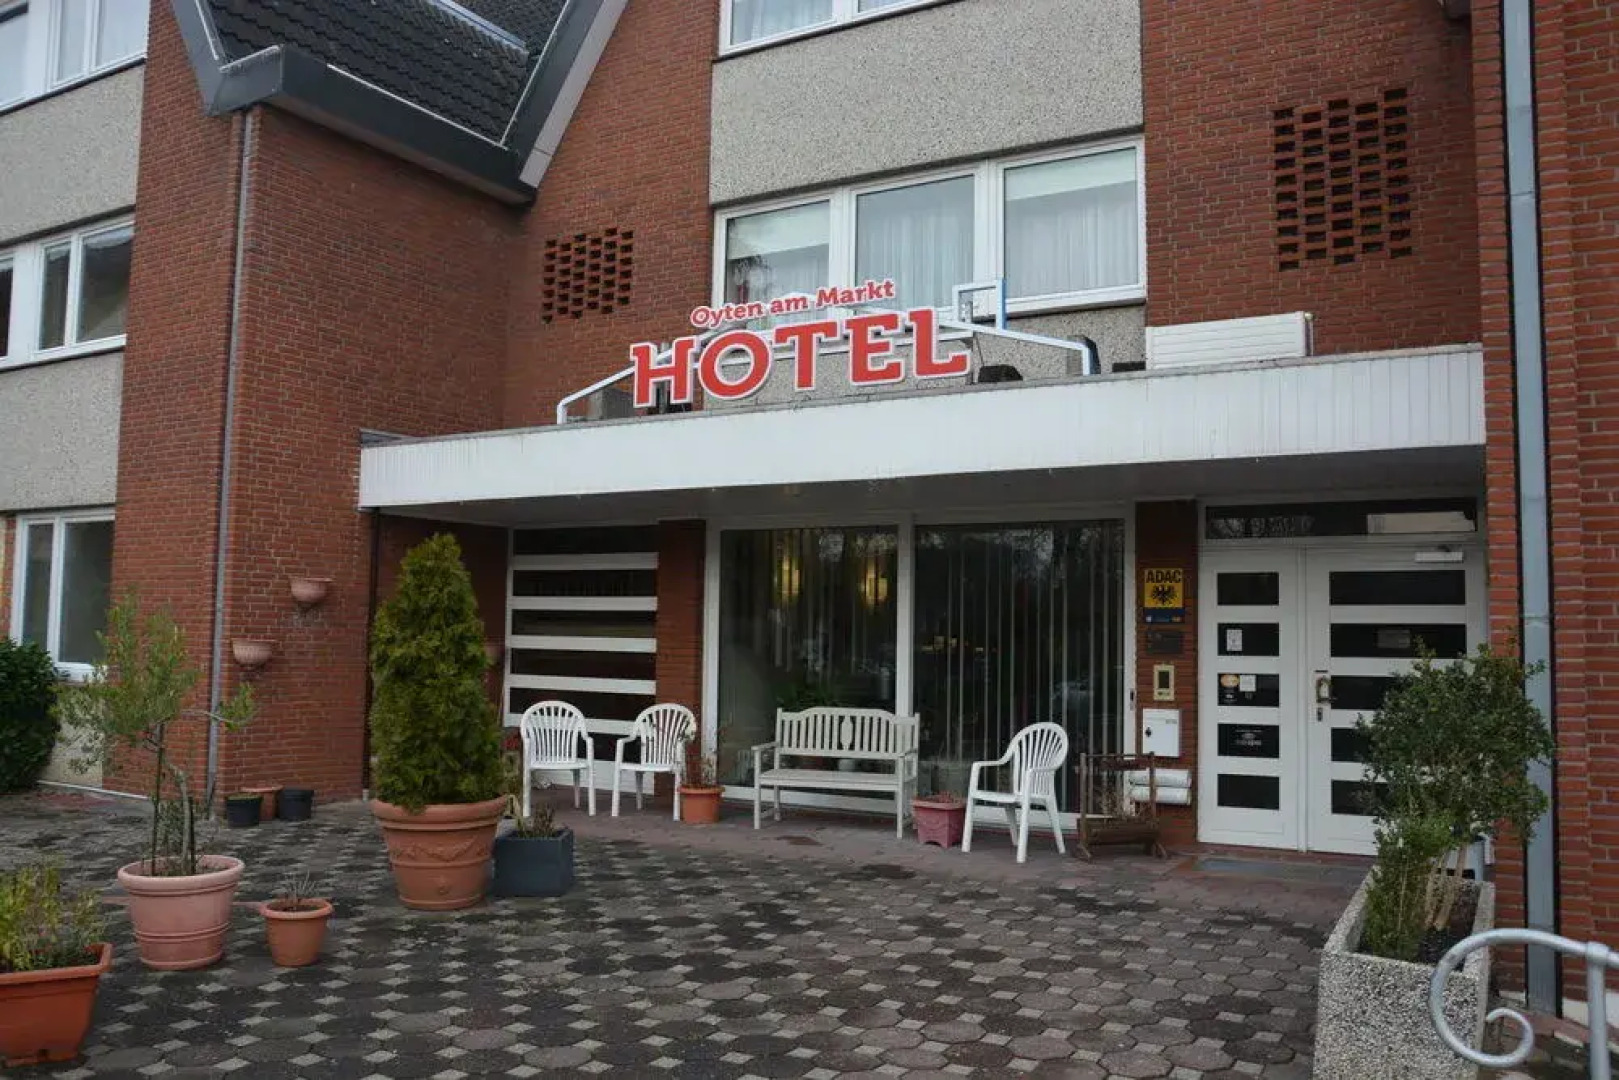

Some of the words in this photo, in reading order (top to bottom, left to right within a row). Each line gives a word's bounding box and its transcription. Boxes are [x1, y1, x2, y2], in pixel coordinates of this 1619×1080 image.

[691, 302, 764, 326] Oyten
[771, 295, 808, 313] am
[817, 280, 895, 306] Markt
[631, 309, 970, 407] HOTEL
[1145, 569, 1182, 583] ADAC
